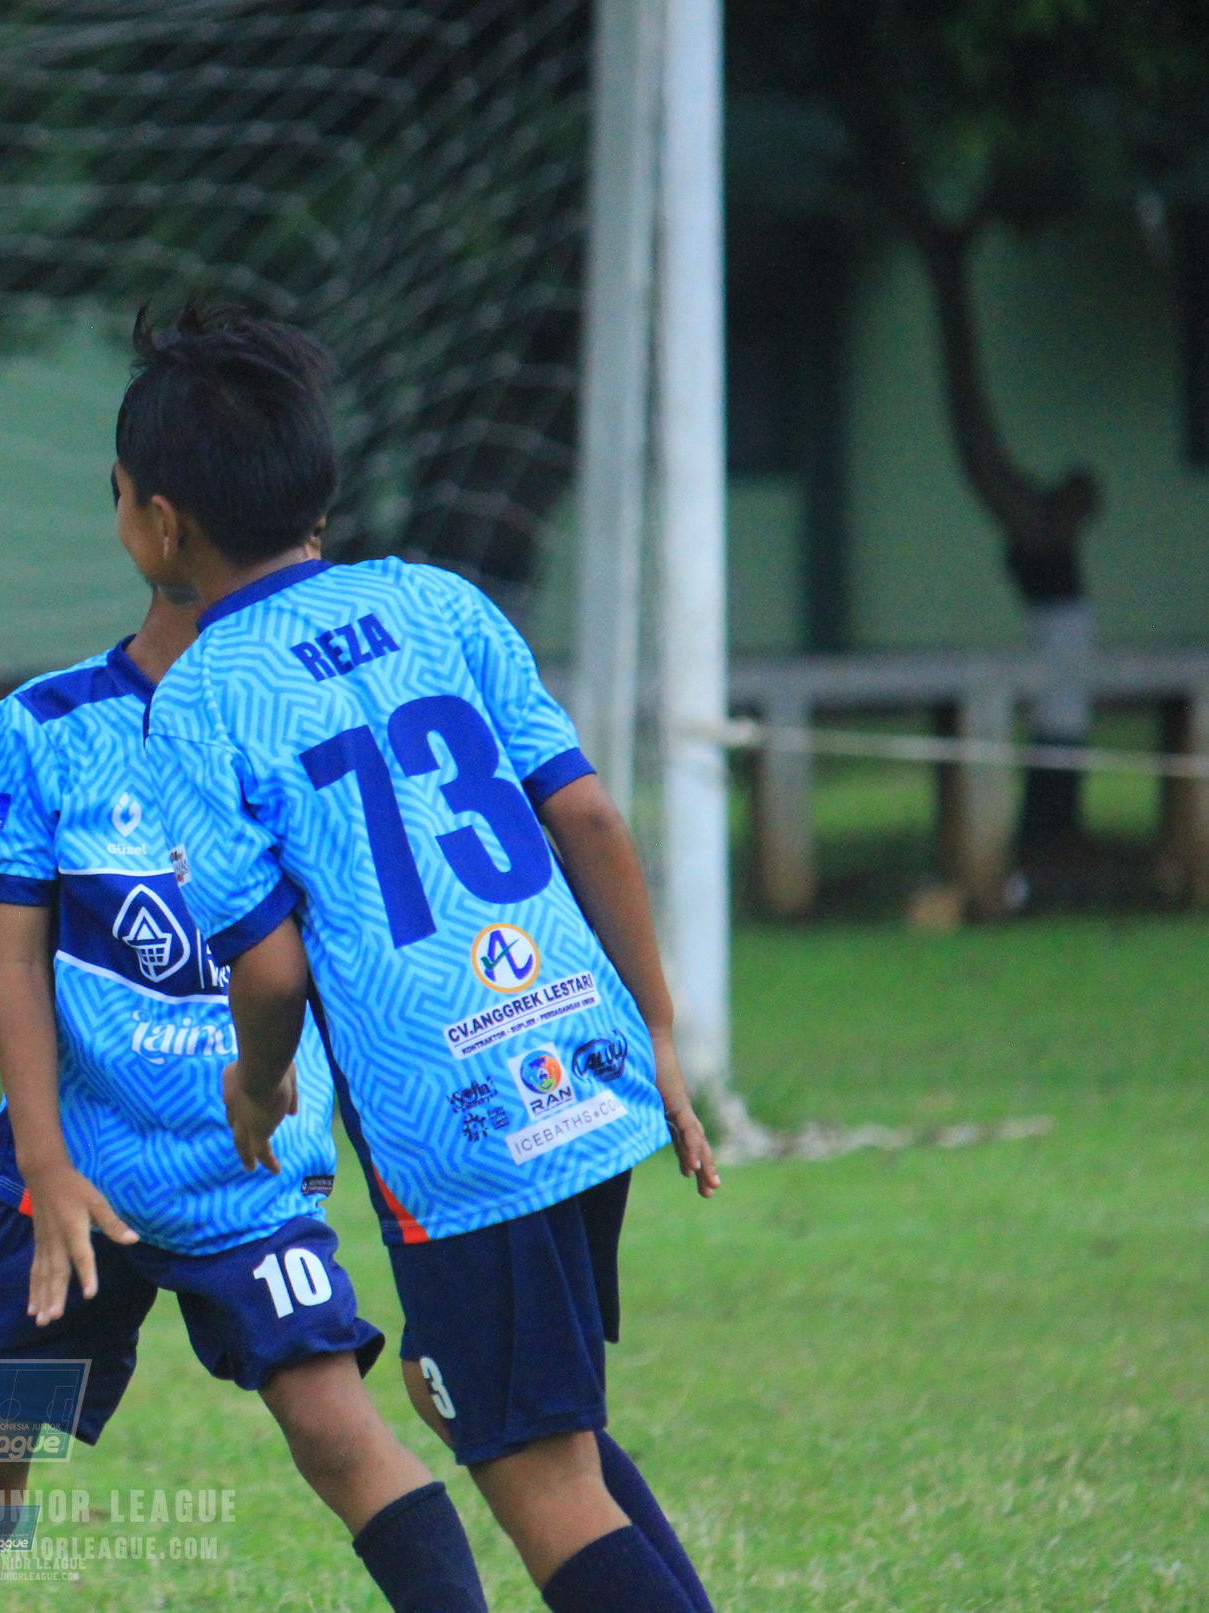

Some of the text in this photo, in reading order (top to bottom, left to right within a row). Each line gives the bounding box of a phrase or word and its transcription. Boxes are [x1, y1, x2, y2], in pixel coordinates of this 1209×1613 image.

[290, 612, 401, 683] REZA
[298, 694, 553, 950] 73
[448, 973, 594, 1042] CV.ANGGREK LESTARI
[530, 1086, 572, 1113] RAN
[253, 1248, 332, 1319] 10
[419, 1356, 456, 1420] 3
